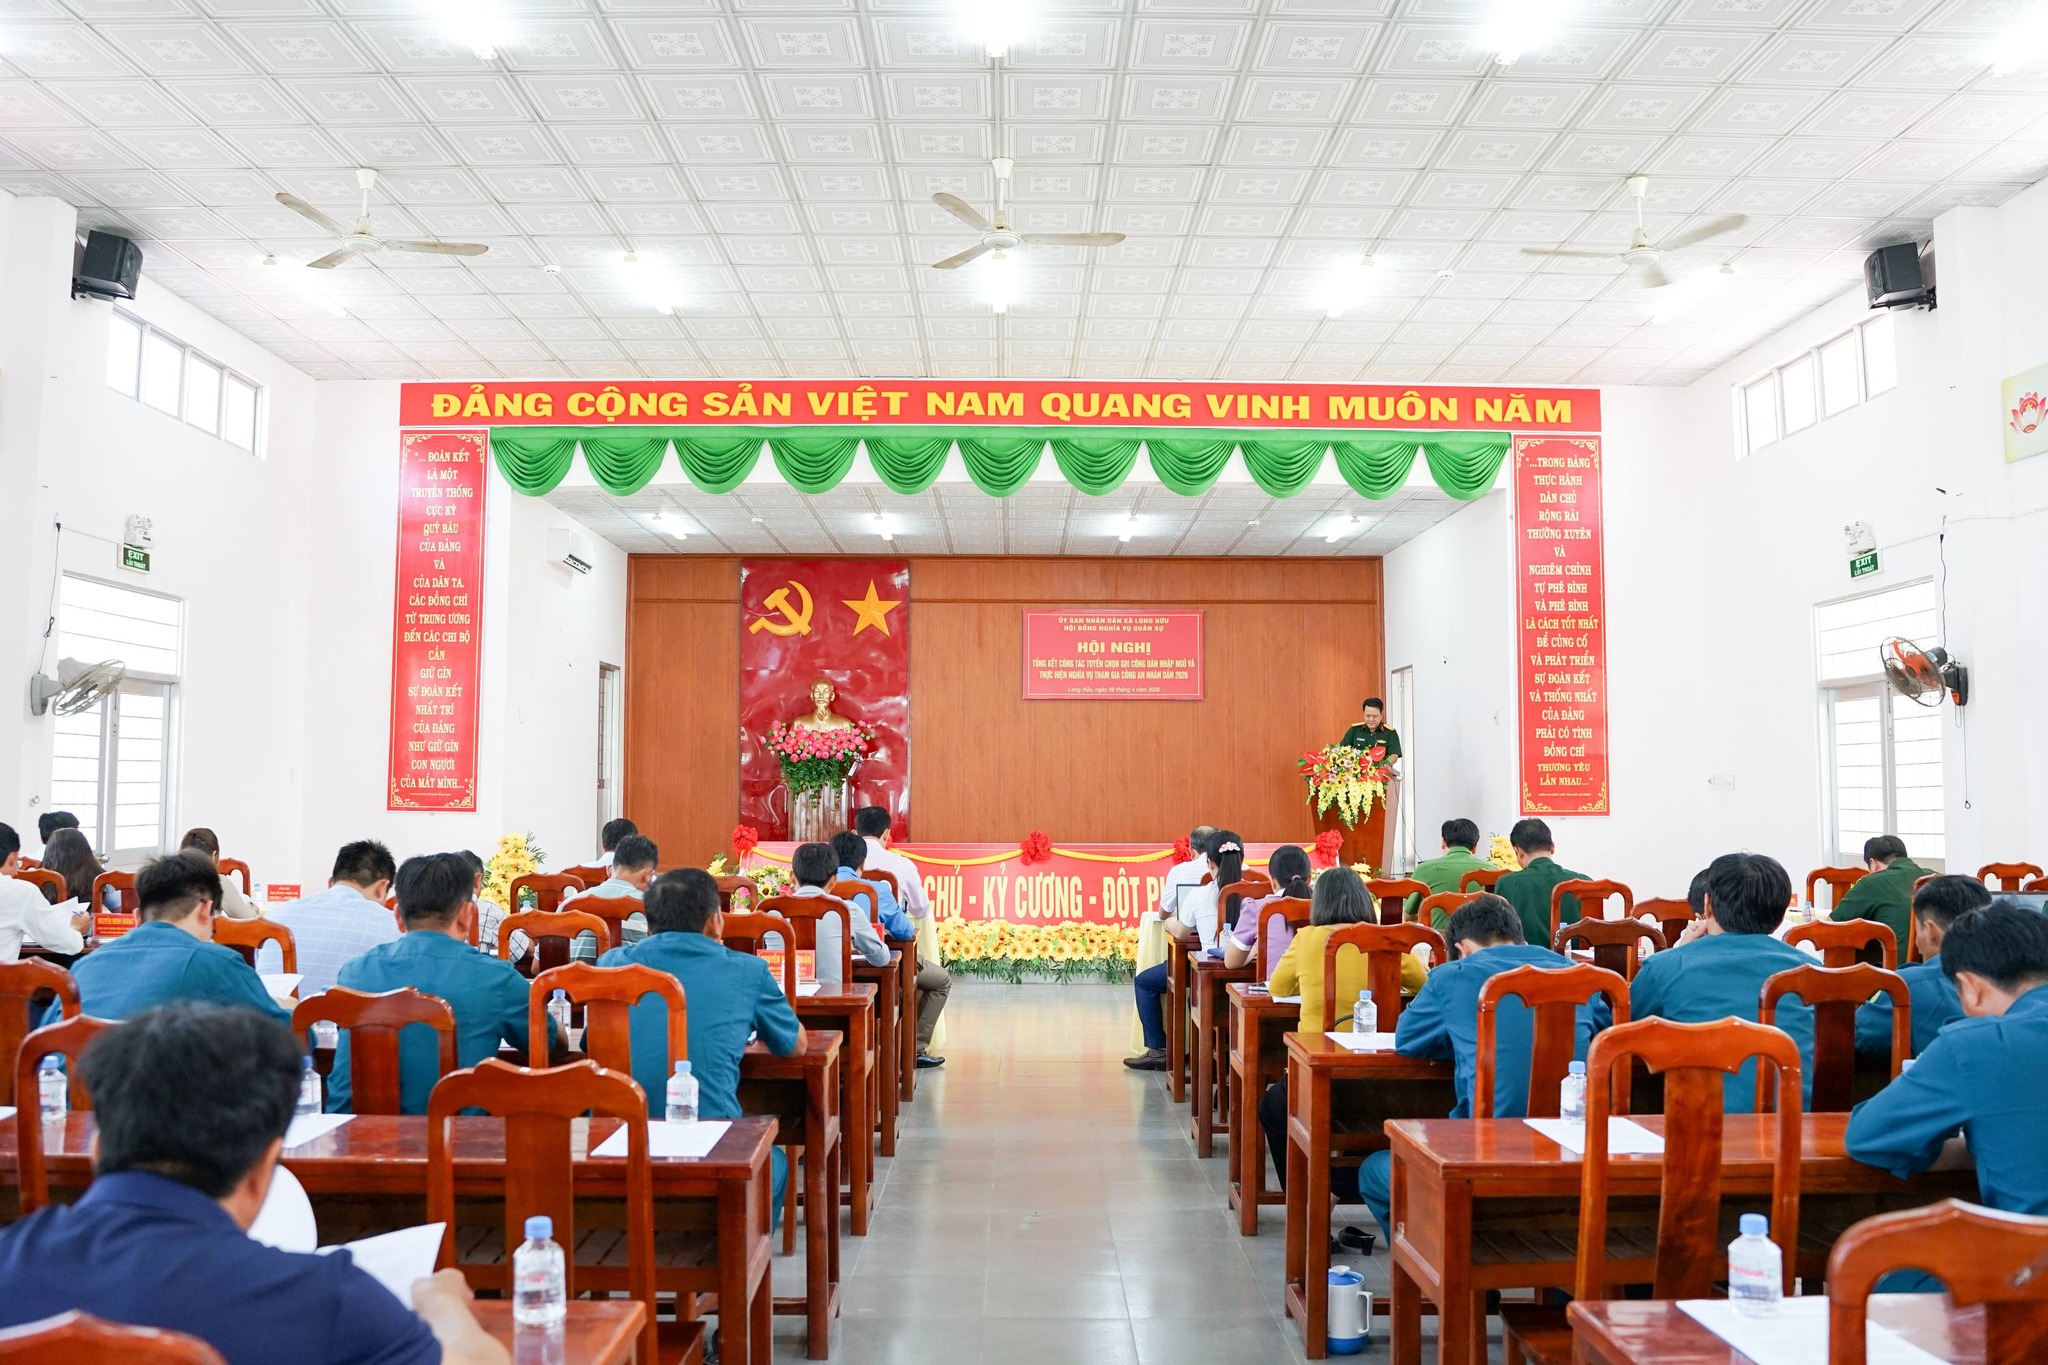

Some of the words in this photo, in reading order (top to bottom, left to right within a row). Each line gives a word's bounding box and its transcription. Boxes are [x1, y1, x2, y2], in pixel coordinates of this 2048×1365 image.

[431, 384, 552, 417] ĐẢNG
[567, 386, 687, 421] CỘNG
[701, 383, 791, 417] SẢN
[807, 386, 908, 421] VIỆT
[926, 390, 1024, 418] NAM
[1040, 392, 1191, 422] QUANG
[1206, 394, 1310, 420] VINH
[1328, 390, 1457, 421] MUÔN
[1475, 391, 1572, 423] NĂM
[428, 450, 450, 462] ĐOÀN
[453, 448, 469, 462] KẾT
[1567, 454, 1590, 468] ĐẢNG
[427, 468, 438, 479] LÀ
[440, 468, 458, 480] MỘT
[1534, 474, 1556, 486] THỰC
[1559, 474, 1582, 485] HÀNH
[411, 482, 442, 497] TRUYỀN
[446, 483, 473, 497] THỐNG
[1540, 491, 1557, 503] DÂN
[1560, 490, 1576, 503] CHỦ
[426, 505, 442, 517] CỰC
[1539, 509, 1562, 523] RỘNG
[423, 522, 439, 536] QUÝ
[442, 521, 458, 533] BÁU
[1527, 528, 1561, 539] THƯỜNG
[1564, 528, 1591, 539] XUYÊN
[420, 540, 436, 551] CỦA
[438, 539, 460, 551] ĐẢNG
[1554, 544, 1566, 557] VÀ
[128, 550, 144, 561] EXIT
[1856, 556, 1872, 567] EXIT
[434, 558, 445, 569] VÀ
[1529, 563, 1562, 575] NGHIÊM
[414, 575, 430, 587] CỦA
[432, 576, 449, 587] DÂN
[1534, 582, 1545, 595] TỰ
[1548, 582, 1564, 593] PHÊ
[1567, 581, 1587, 593] BÌNH
[409, 593, 425, 606] CÁC
[428, 590, 450, 606] ĐỒNG
[453, 594, 467, 606] CHÍ
[1535, 599, 1546, 611] VÀ
[1549, 599, 1565, 611] PHÊ
[1568, 599, 1588, 611] BÌNH
[405, 612, 416, 624] TỪ
[419, 614, 446, 624] TRUNG
[448, 614, 470, 624] ƯƠNG
[1526, 616, 1536, 629] LÀ
[1538, 616, 1559, 629] CÁCH
[1561, 615, 1576, 629] TỐT
[1578, 615, 1598, 629] NHẤT
[404, 628, 421, 642] ĐẾN
[423, 629, 440, 642] CÁC
[443, 632, 456, 642] CHI
[459, 630, 470, 644] BỘ
[1537, 632, 1548, 647] ĐỂ
[1551, 634, 1574, 647] CỦNG
[1576, 633, 1587, 647] CỐ
[429, 645, 445, 660] CẦN
[1078, 640, 1105, 655] HỘI
[1111, 642, 1151, 655] NGHỊ
[1531, 653, 1542, 665] VÀ
[1545, 653, 1566, 665] PHÁT
[1569, 650, 1594, 665] TRIỂN
[420, 666, 435, 678] GIỮ
[437, 666, 451, 678] GÌN
[1535, 672, 1546, 686] SỰ
[1548, 671, 1570, 683] ĐOÀN
[1574, 669, 1590, 683] KẾT
[408, 686, 419, 698] SỰ
[421, 684, 443, 696] ĐOÀN
[445, 682, 462, 697] KẾT
[1529, 689, 1541, 702] VÀ
[1544, 688, 1572, 702] THỐNG
[1574, 688, 1597, 702] NHẤT
[416, 702, 438, 715] NHẤT
[440, 703, 454, 715] TRÍ
[1542, 707, 1559, 720] CỦA
[1562, 707, 1584, 720] ĐẢNG
[414, 721, 430, 733] CỦA
[432, 721, 455, 733] ĐẢNG
[1536, 725, 1556, 738] PHẢI
[1558, 726, 1569, 738] CÓ
[1572, 725, 1592, 738] TÌNH
[408, 741, 426, 751] NHƯ
[428, 739, 442, 751] GIỮ
[445, 739, 459, 751] GÌN
[1544, 741, 1567, 756] ĐỒNG
[1570, 744, 1584, 756] CHÍ
[412, 760, 427, 770] CON
[1537, 763, 1571, 771] THƯƠNG
[1573, 763, 1590, 771] YÊU
[400, 775, 416, 788] CỦA
[418, 773, 435, 788] MẮT
[923, 865, 962, 918] CHỦ
[983, 863, 1008, 918] KỶ
[1015, 871, 1082, 918] CƯƠNG
[1103, 867, 1139, 927] ĐỘT
[1146, 876, 1164, 912] P
